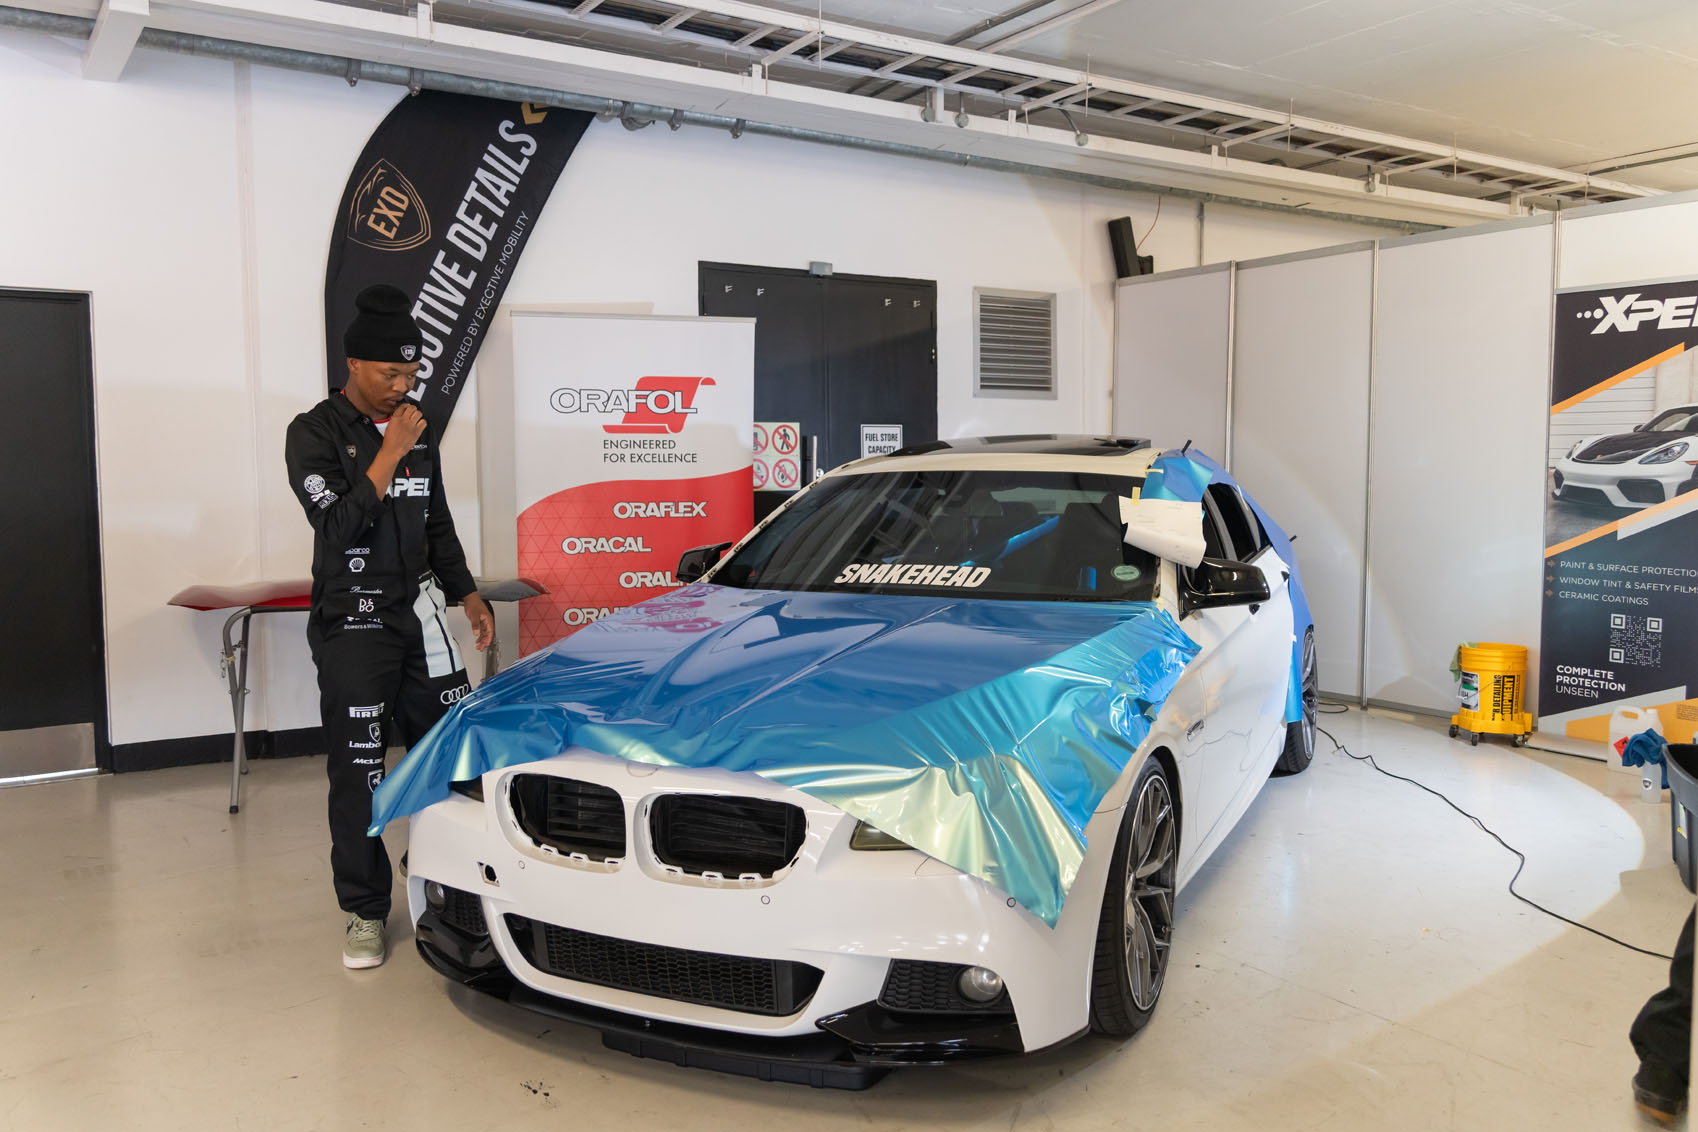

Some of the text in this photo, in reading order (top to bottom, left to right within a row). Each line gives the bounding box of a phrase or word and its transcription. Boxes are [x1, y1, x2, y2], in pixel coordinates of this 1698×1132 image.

[446, 120, 537, 262] DETAILS
[367, 186, 409, 239] EXD
[441, 210, 529, 395] POWERED BY EXECTIVE MOBILITY
[1591, 293, 1698, 334] XPE
[550, 387, 698, 414] ORAFOL
[603, 439, 676, 450] ENGINEERED
[865, 433, 898, 442] FUEL STORE
[603, 452, 697, 463] FOR EXCELLENCE
[868, 445, 896, 454] CAPACITY
[613, 501, 708, 519] ORAFLEX
[561, 536, 652, 555] ORACAL
[834, 563, 992, 588] SNAKEHEAD
[1560, 560, 1586, 569] PAINT
[1596, 563, 1639, 574] SURFACE
[1642, 567, 1698, 578] PROTECTIO
[619, 570, 691, 588] ORAL
[1559, 576, 1600, 586] WINDOW
[1602, 579, 1623, 588] TINT
[1625, 581, 1632, 589] &
[1634, 582, 1671, 592] SAFETY
[1559, 591, 1649, 606] CERAMIC COATINGS
[1556, 665, 1614, 680] COMPLETE
[1555, 685, 1599, 698] UNSEEN
[1556, 675, 1626, 692] PROTECTION
